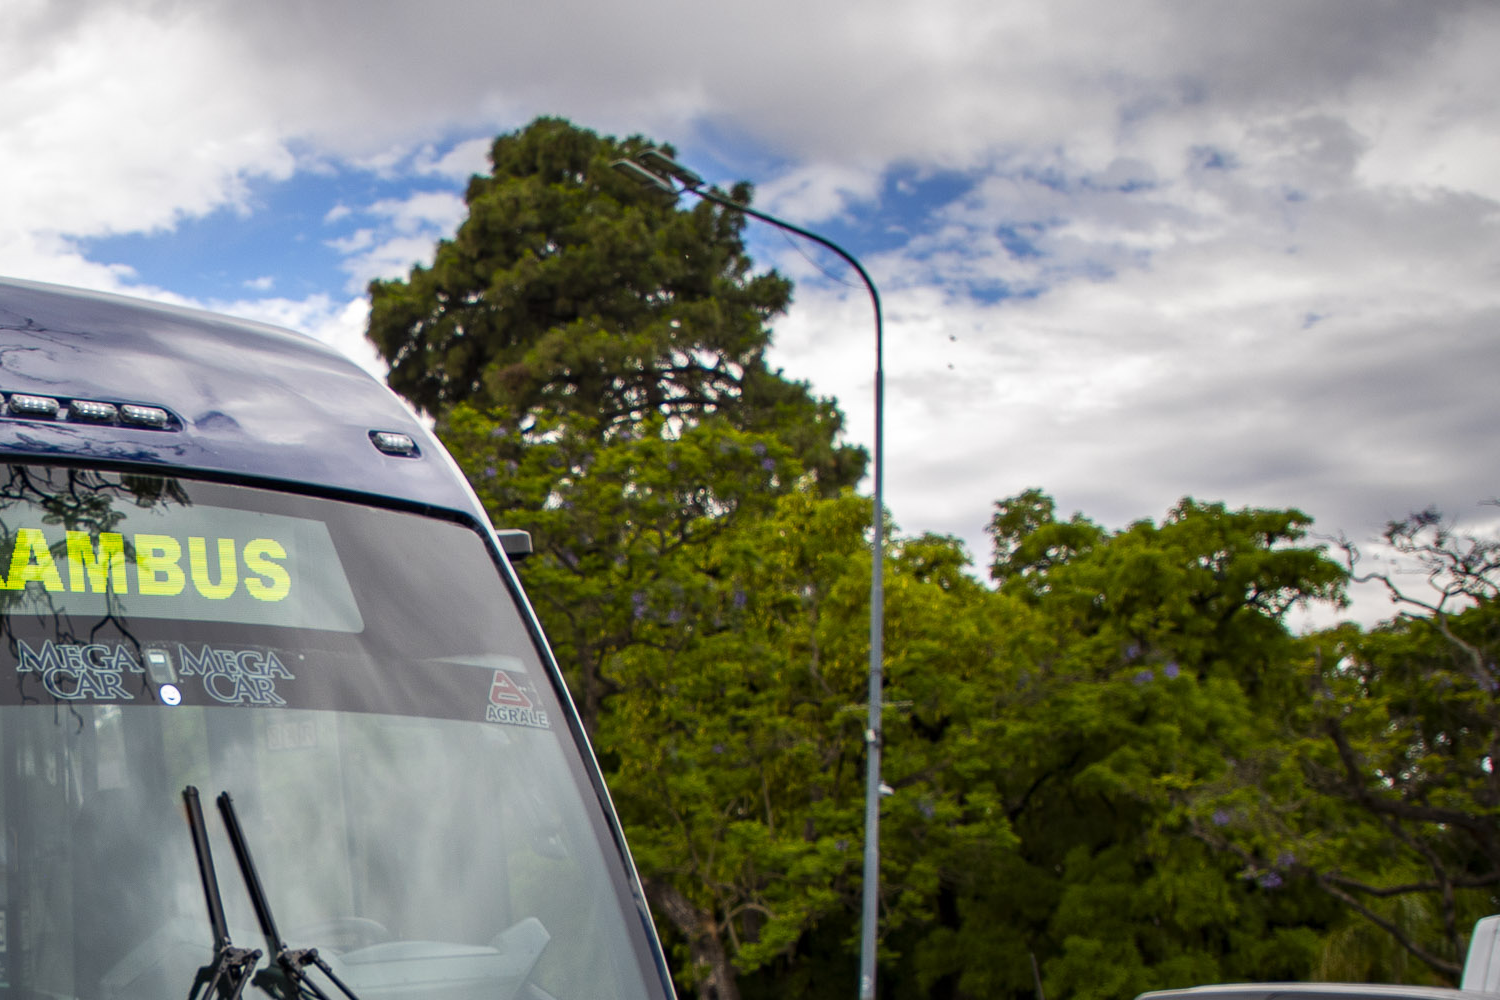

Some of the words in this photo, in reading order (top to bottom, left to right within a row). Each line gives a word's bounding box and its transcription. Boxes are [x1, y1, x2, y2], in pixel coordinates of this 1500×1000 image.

[16, 639, 145, 672] MEGA
[179, 643, 295, 680] MEGA
[43, 668, 134, 699] CAR
[203, 672, 287, 705] CAR
[486, 703, 549, 729] AGRALE
